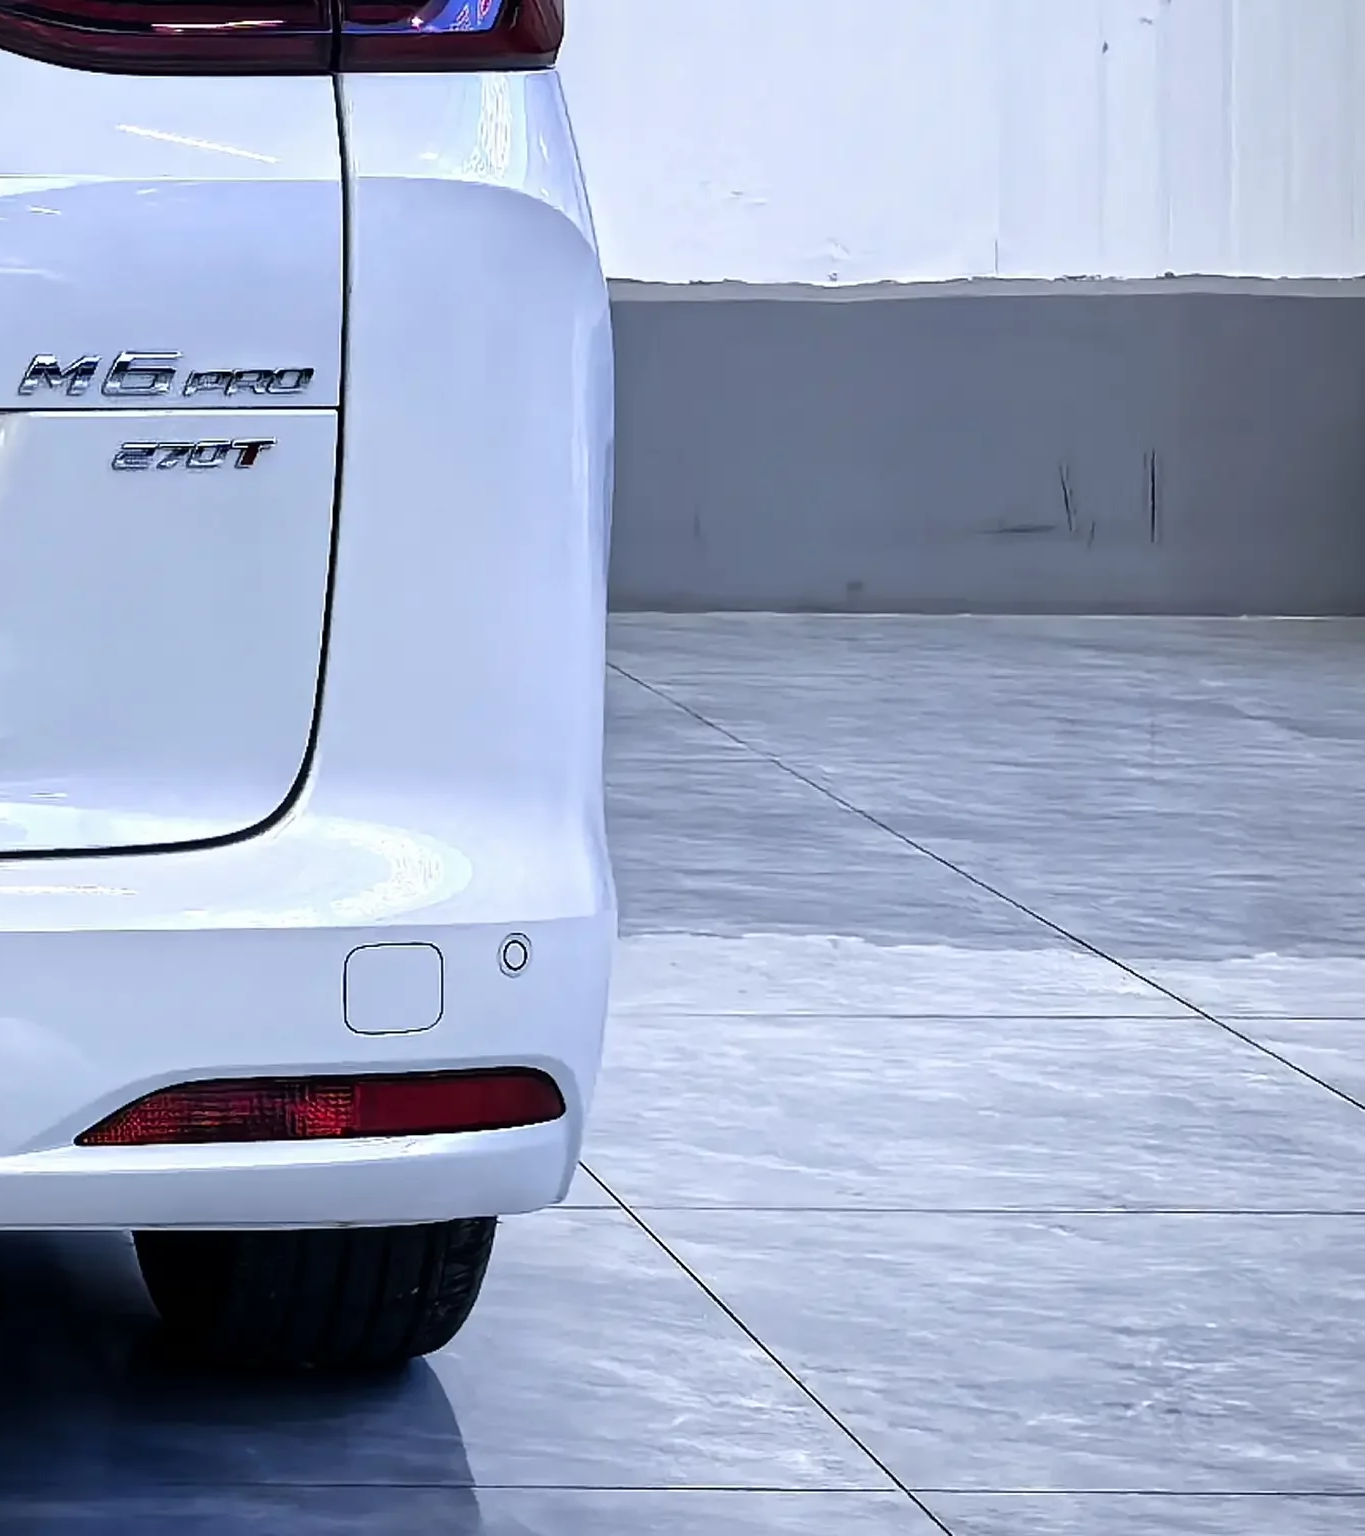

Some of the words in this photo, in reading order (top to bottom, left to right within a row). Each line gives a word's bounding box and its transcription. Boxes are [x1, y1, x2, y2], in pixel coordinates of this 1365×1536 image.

[18, 350, 183, 397] M6
[182, 367, 316, 397] PRO
[111, 436, 278, 471] 270T
